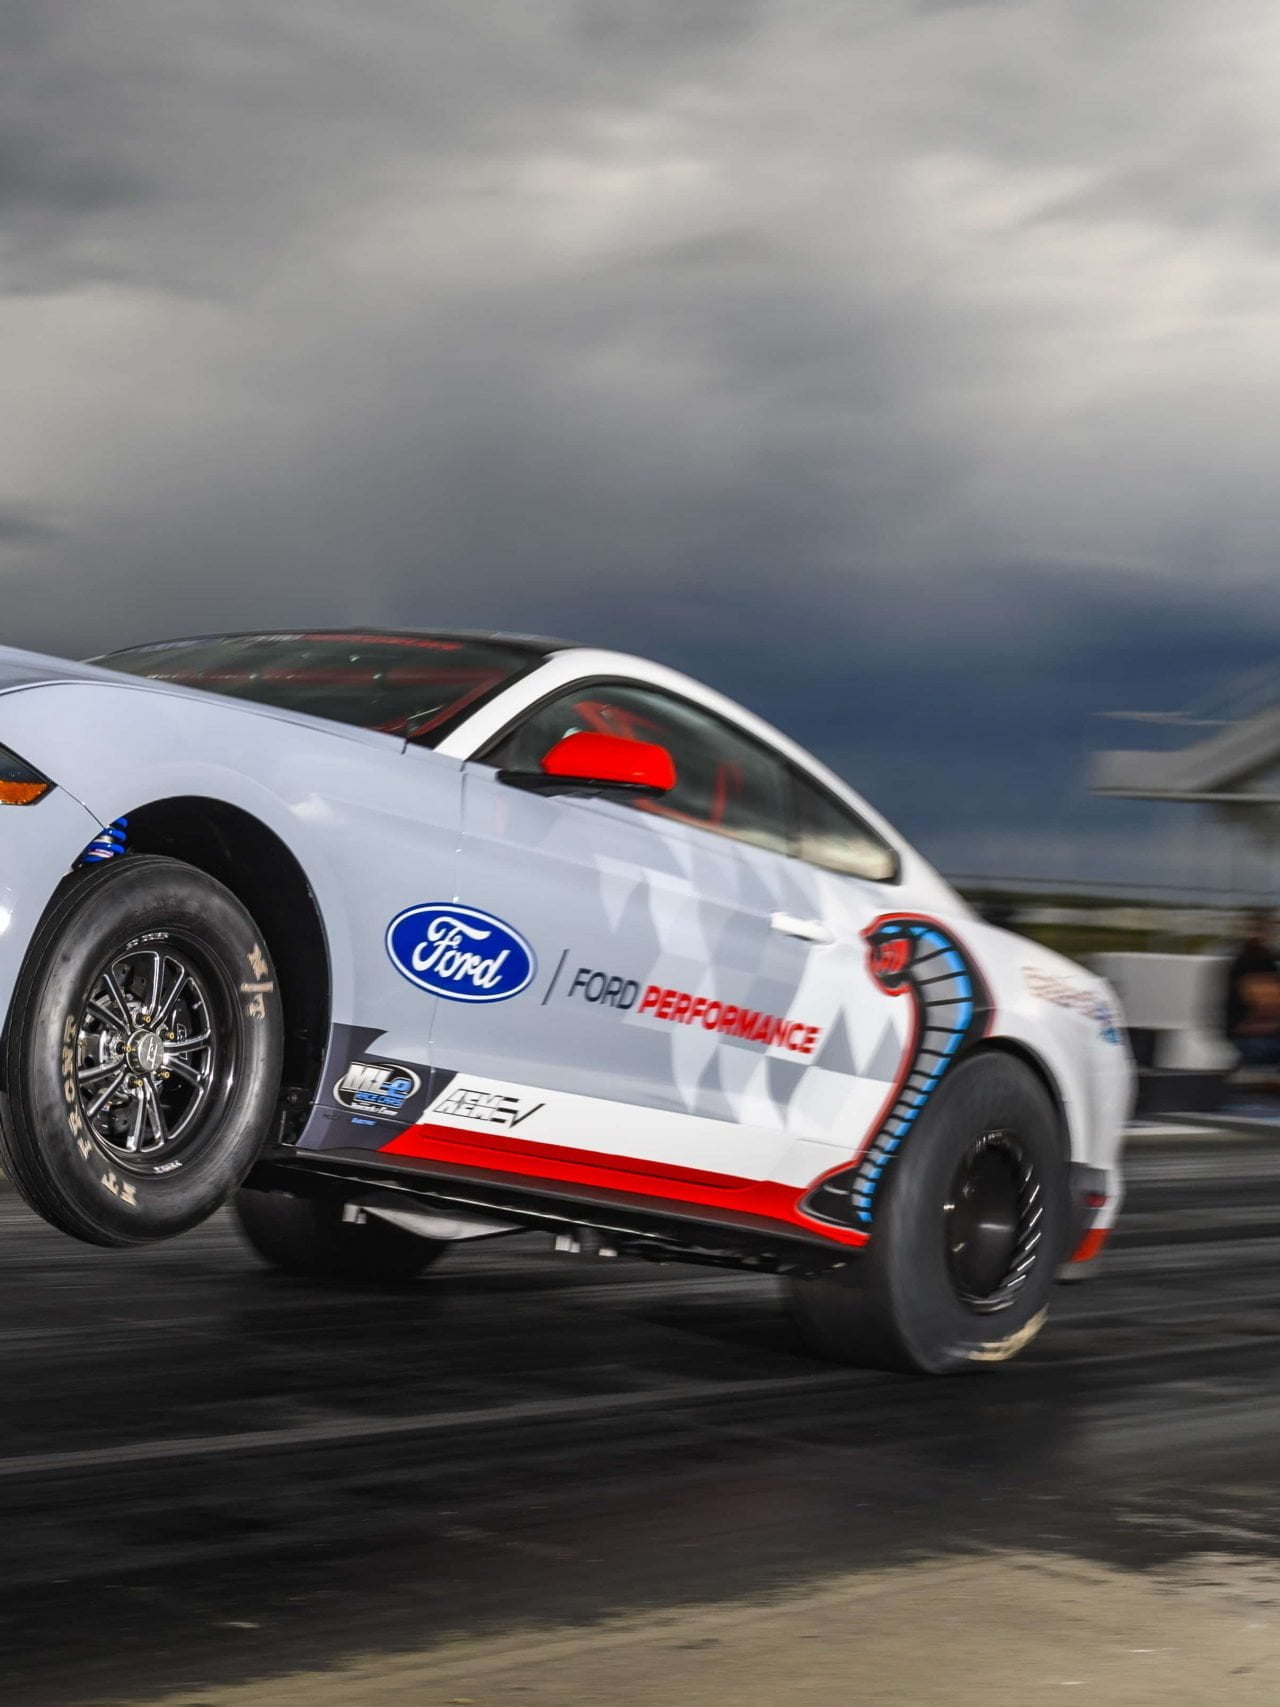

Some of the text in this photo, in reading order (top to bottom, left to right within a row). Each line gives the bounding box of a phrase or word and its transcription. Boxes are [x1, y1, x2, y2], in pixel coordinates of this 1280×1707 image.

[412, 916, 511, 989] Ford
[568, 968, 822, 1055] FORD PERFORMANCE
[61, 1014, 93, 1160] FRONT
